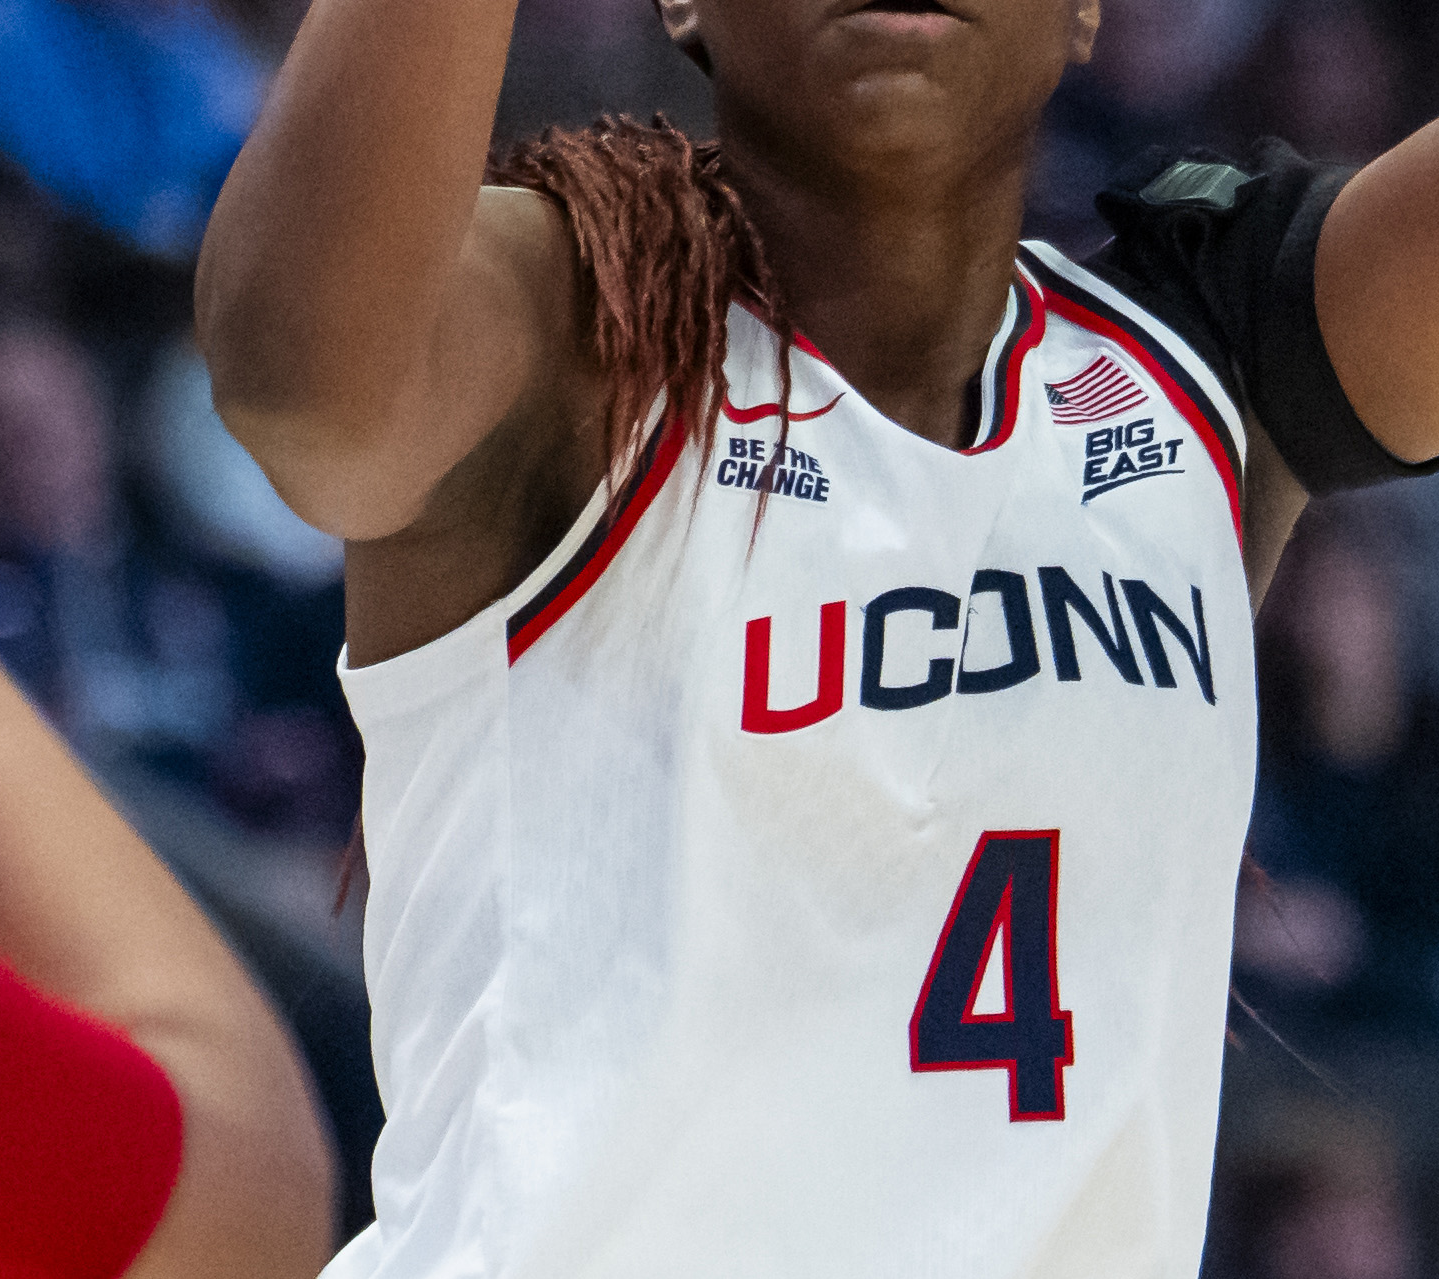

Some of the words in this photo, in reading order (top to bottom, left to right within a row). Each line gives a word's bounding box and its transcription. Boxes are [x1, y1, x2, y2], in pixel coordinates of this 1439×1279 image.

[729, 437, 765, 462] BE
[1085, 417, 1155, 458] BIG
[1083, 438, 1184, 486] EAST
[740, 566, 1217, 735] UCONN
[909, 828, 1074, 1123] 4
